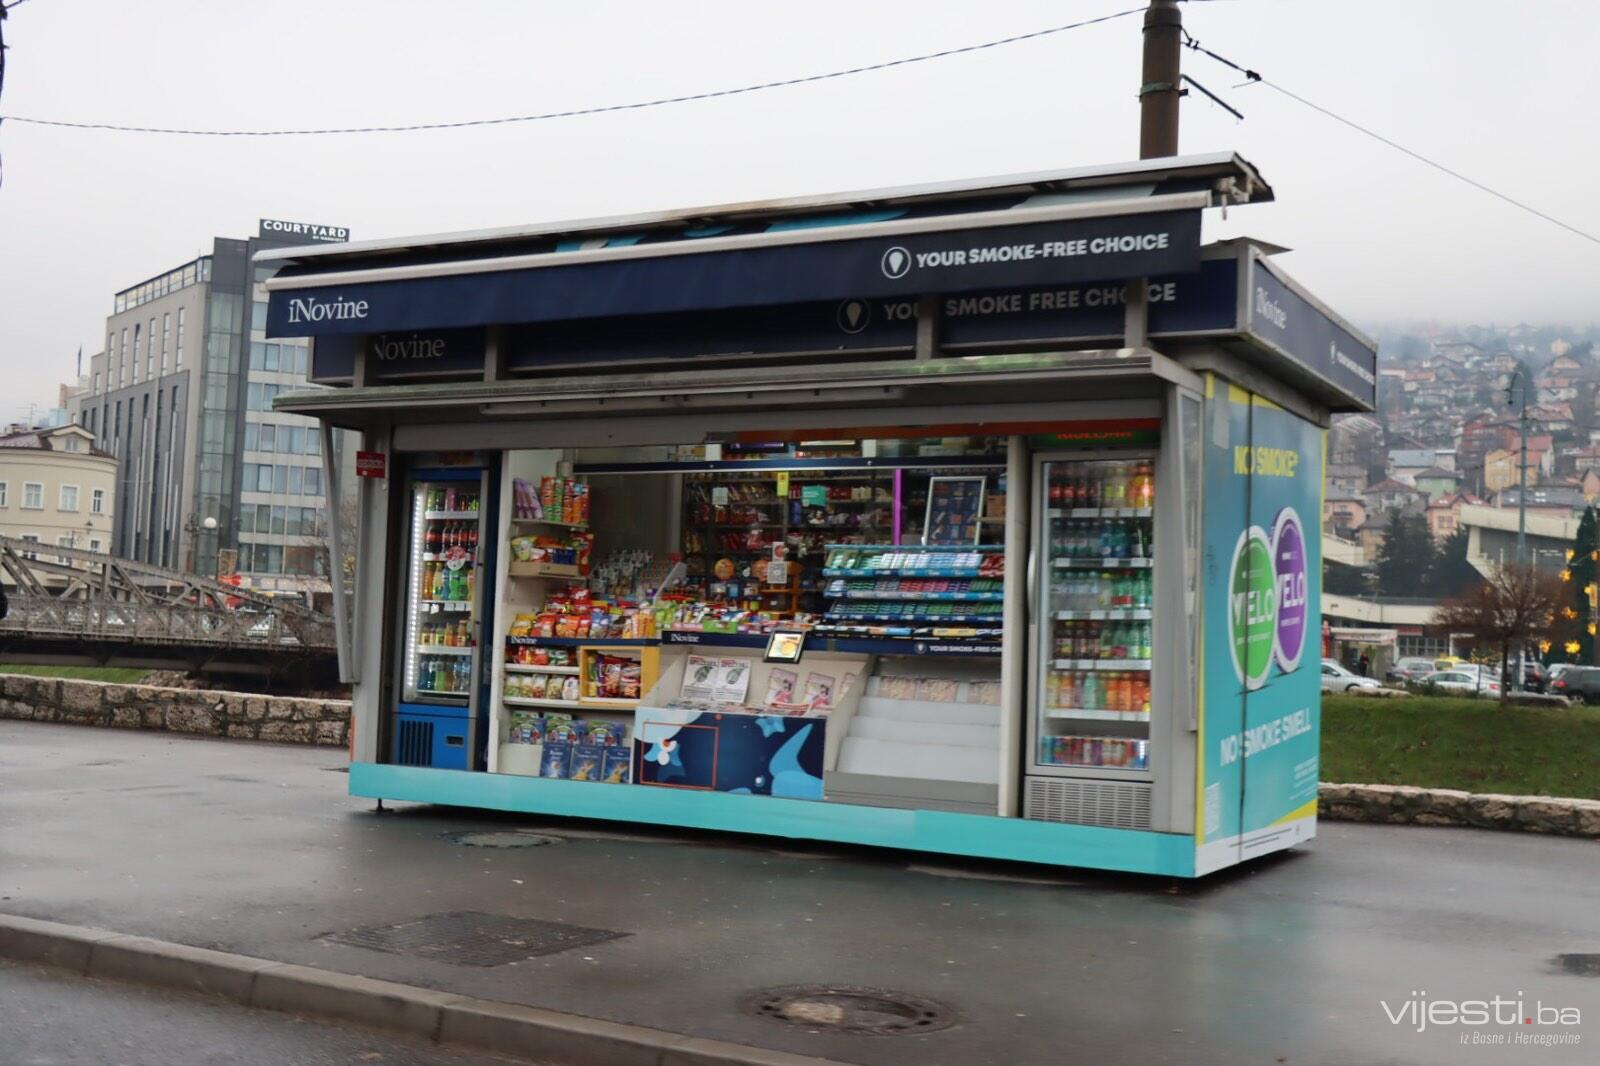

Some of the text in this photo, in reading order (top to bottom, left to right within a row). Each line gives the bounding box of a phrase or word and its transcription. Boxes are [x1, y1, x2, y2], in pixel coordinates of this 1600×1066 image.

[263, 220, 346, 238] COURTYARD
[916, 233, 1168, 268] YOUR SMOKE-FREE CHOICE
[288, 296, 368, 323] iNovine
[945, 294, 1021, 316] SMOKE
[1029, 290, 1079, 311] FREE
[1085, 282, 1176, 307] CHCE
[1220, 735, 1237, 766] NO
[1239, 719, 1281, 758] SMOKE
